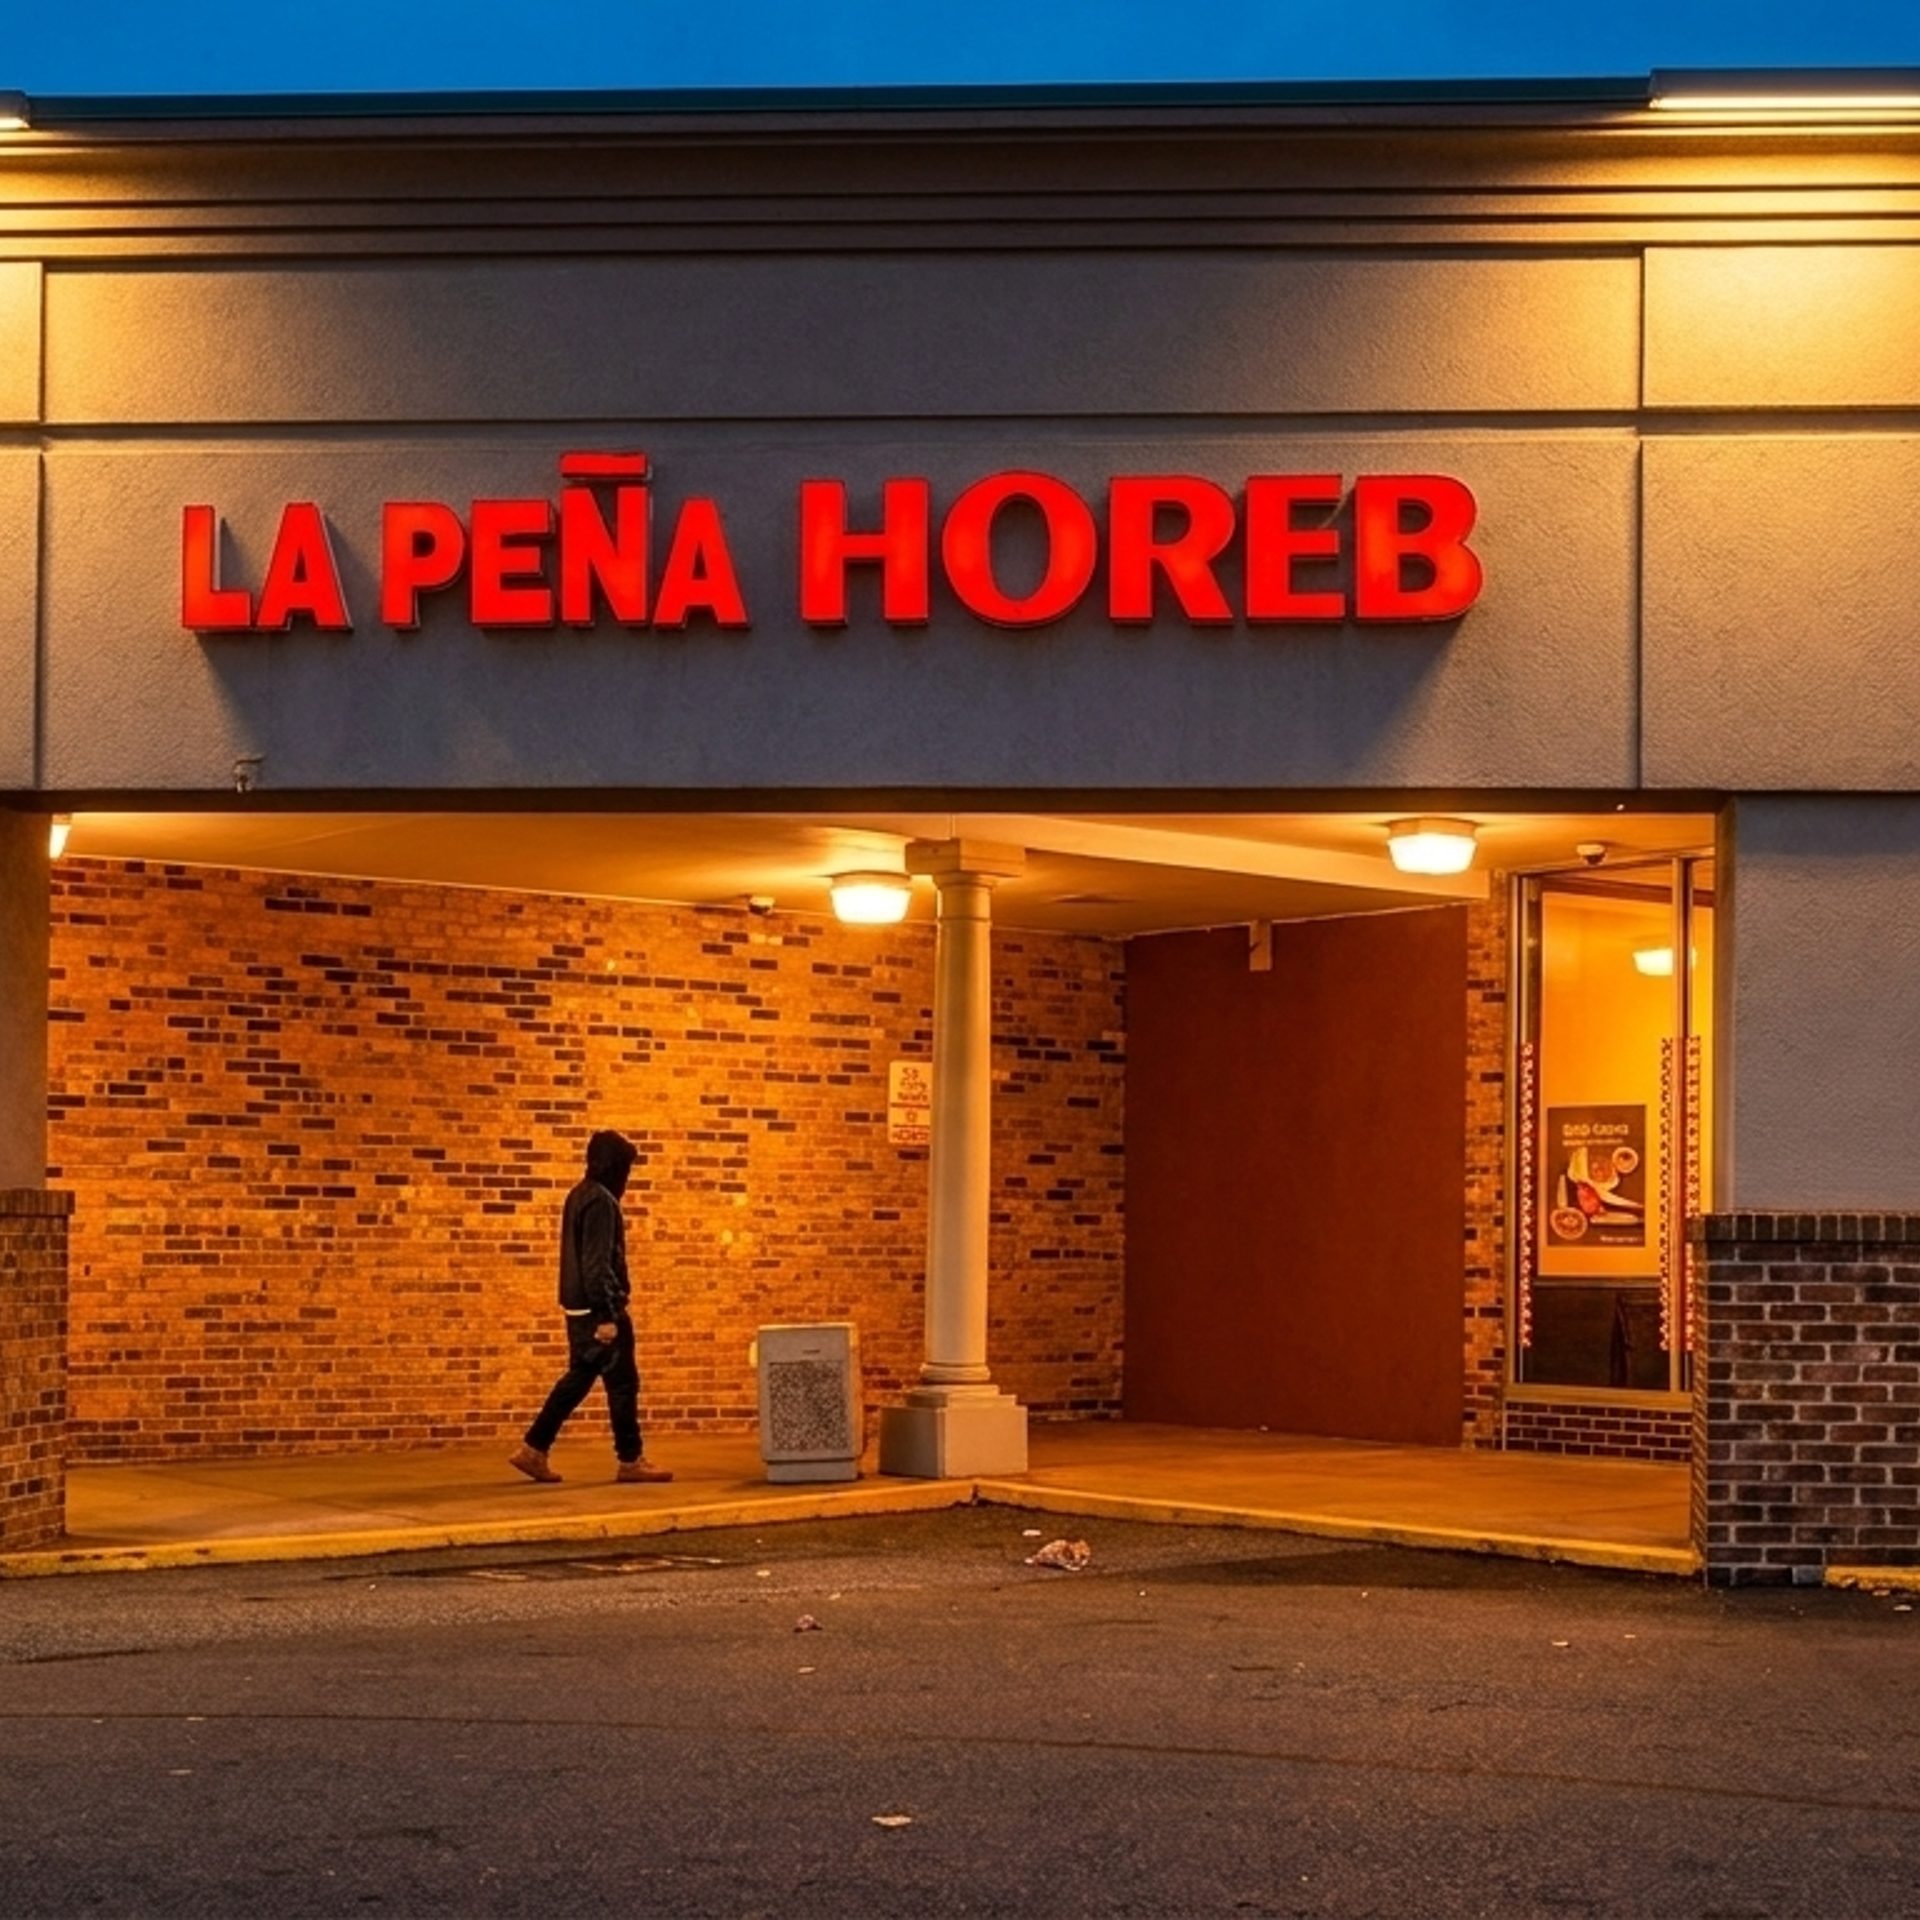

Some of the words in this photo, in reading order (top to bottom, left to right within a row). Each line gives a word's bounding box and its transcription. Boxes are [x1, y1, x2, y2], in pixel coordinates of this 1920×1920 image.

[182, 502, 352, 631] LA
[382, 452, 749, 628] PEÑA
[799, 471, 1484, 626] HOREB
